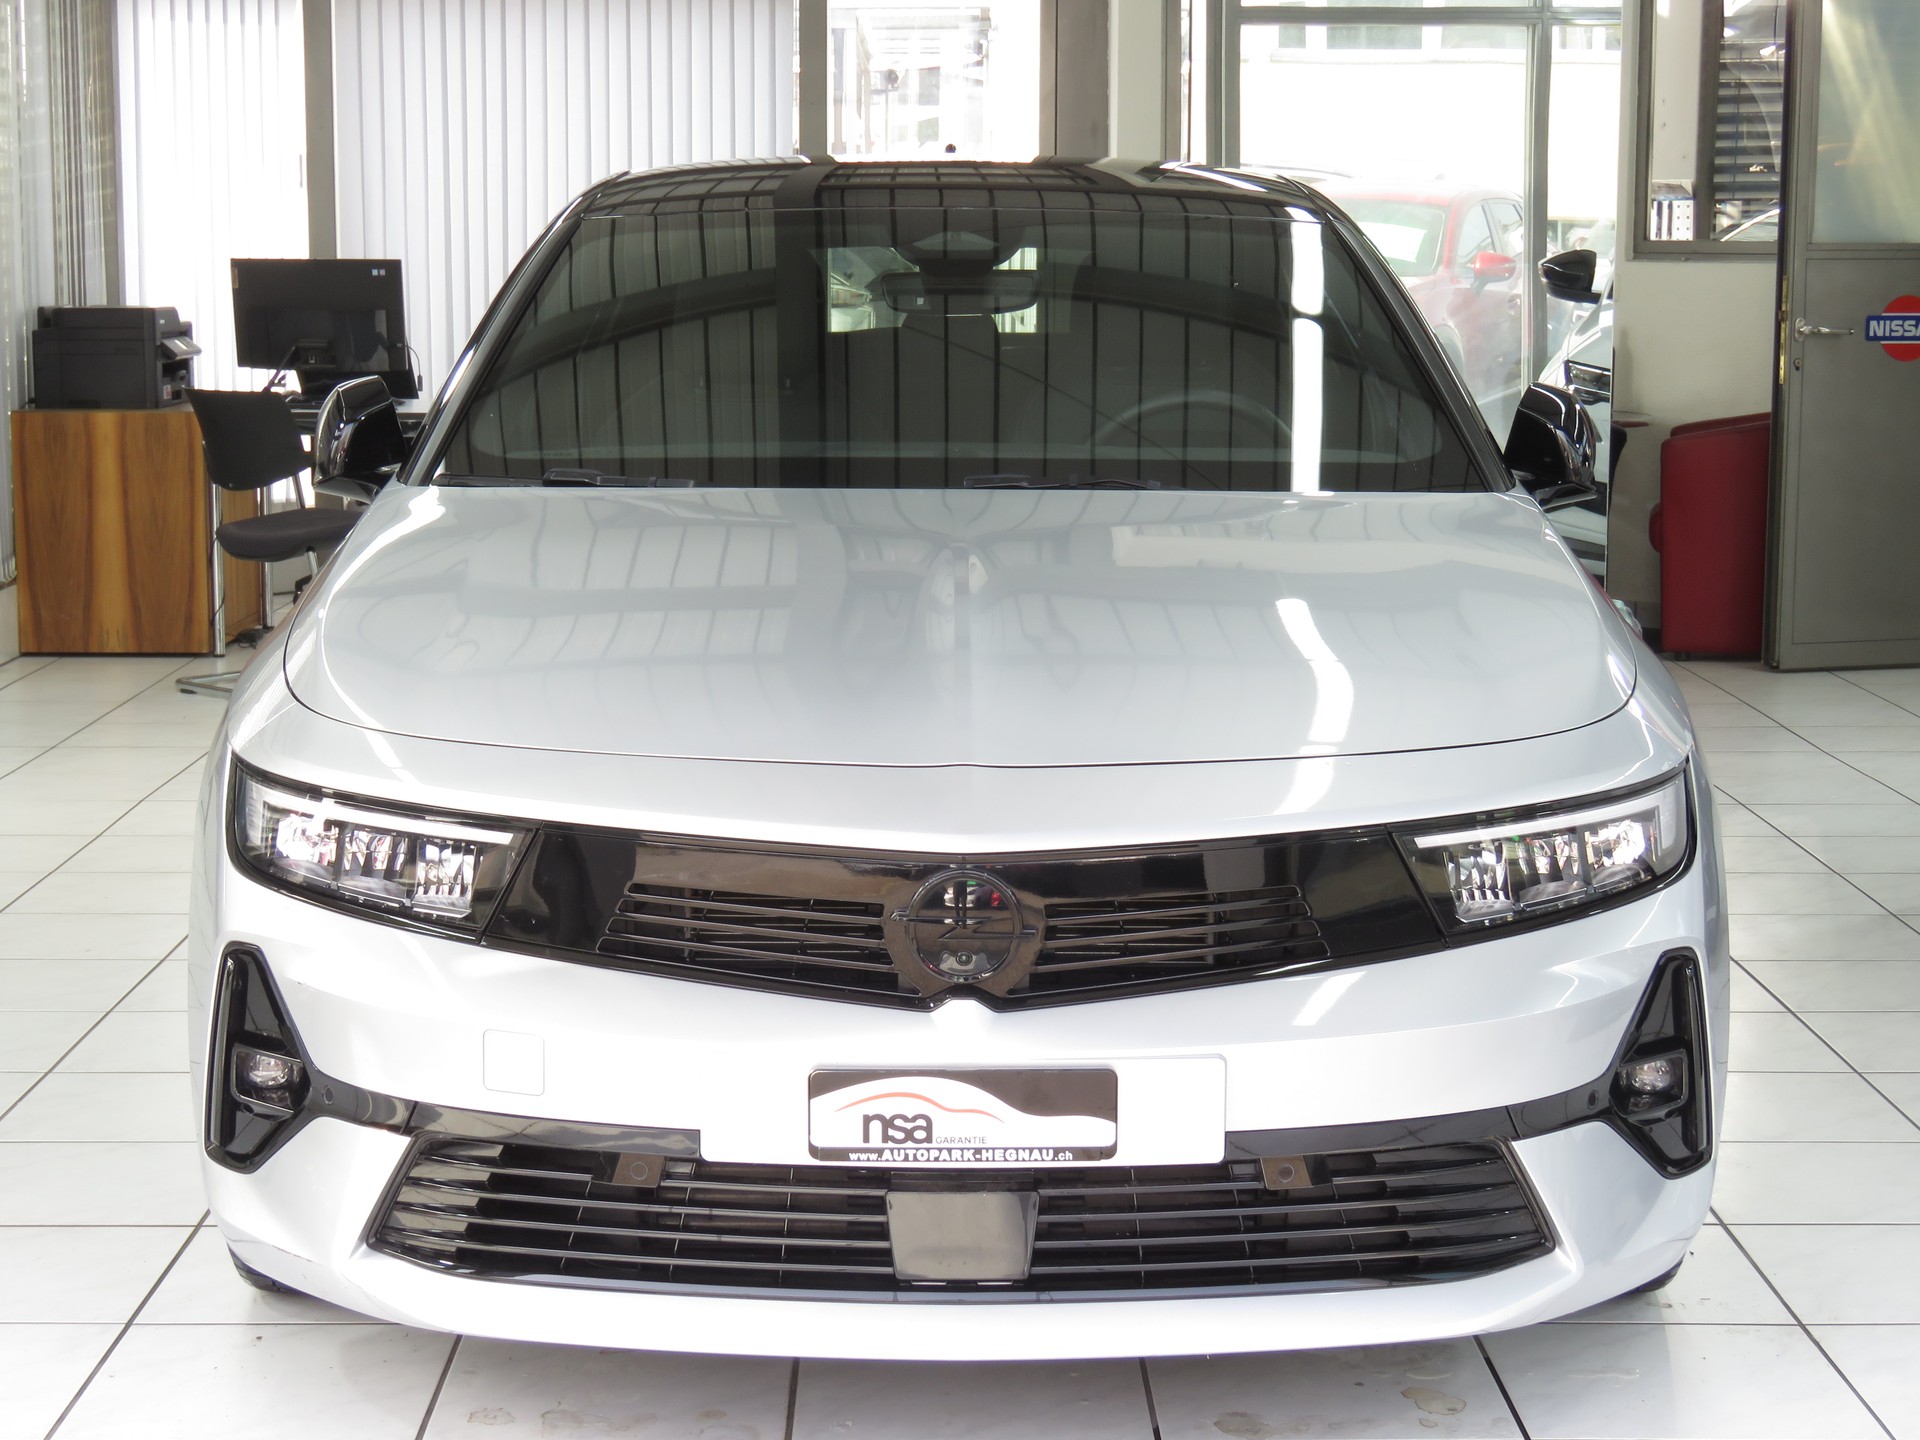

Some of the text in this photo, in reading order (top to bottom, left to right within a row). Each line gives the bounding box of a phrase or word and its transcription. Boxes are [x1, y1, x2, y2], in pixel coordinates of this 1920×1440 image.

[862, 1113, 987, 1144] nsa GARANTIE
[848, 1148, 1073, 1162] www.AUTOPARK-HEGNAU.ch
